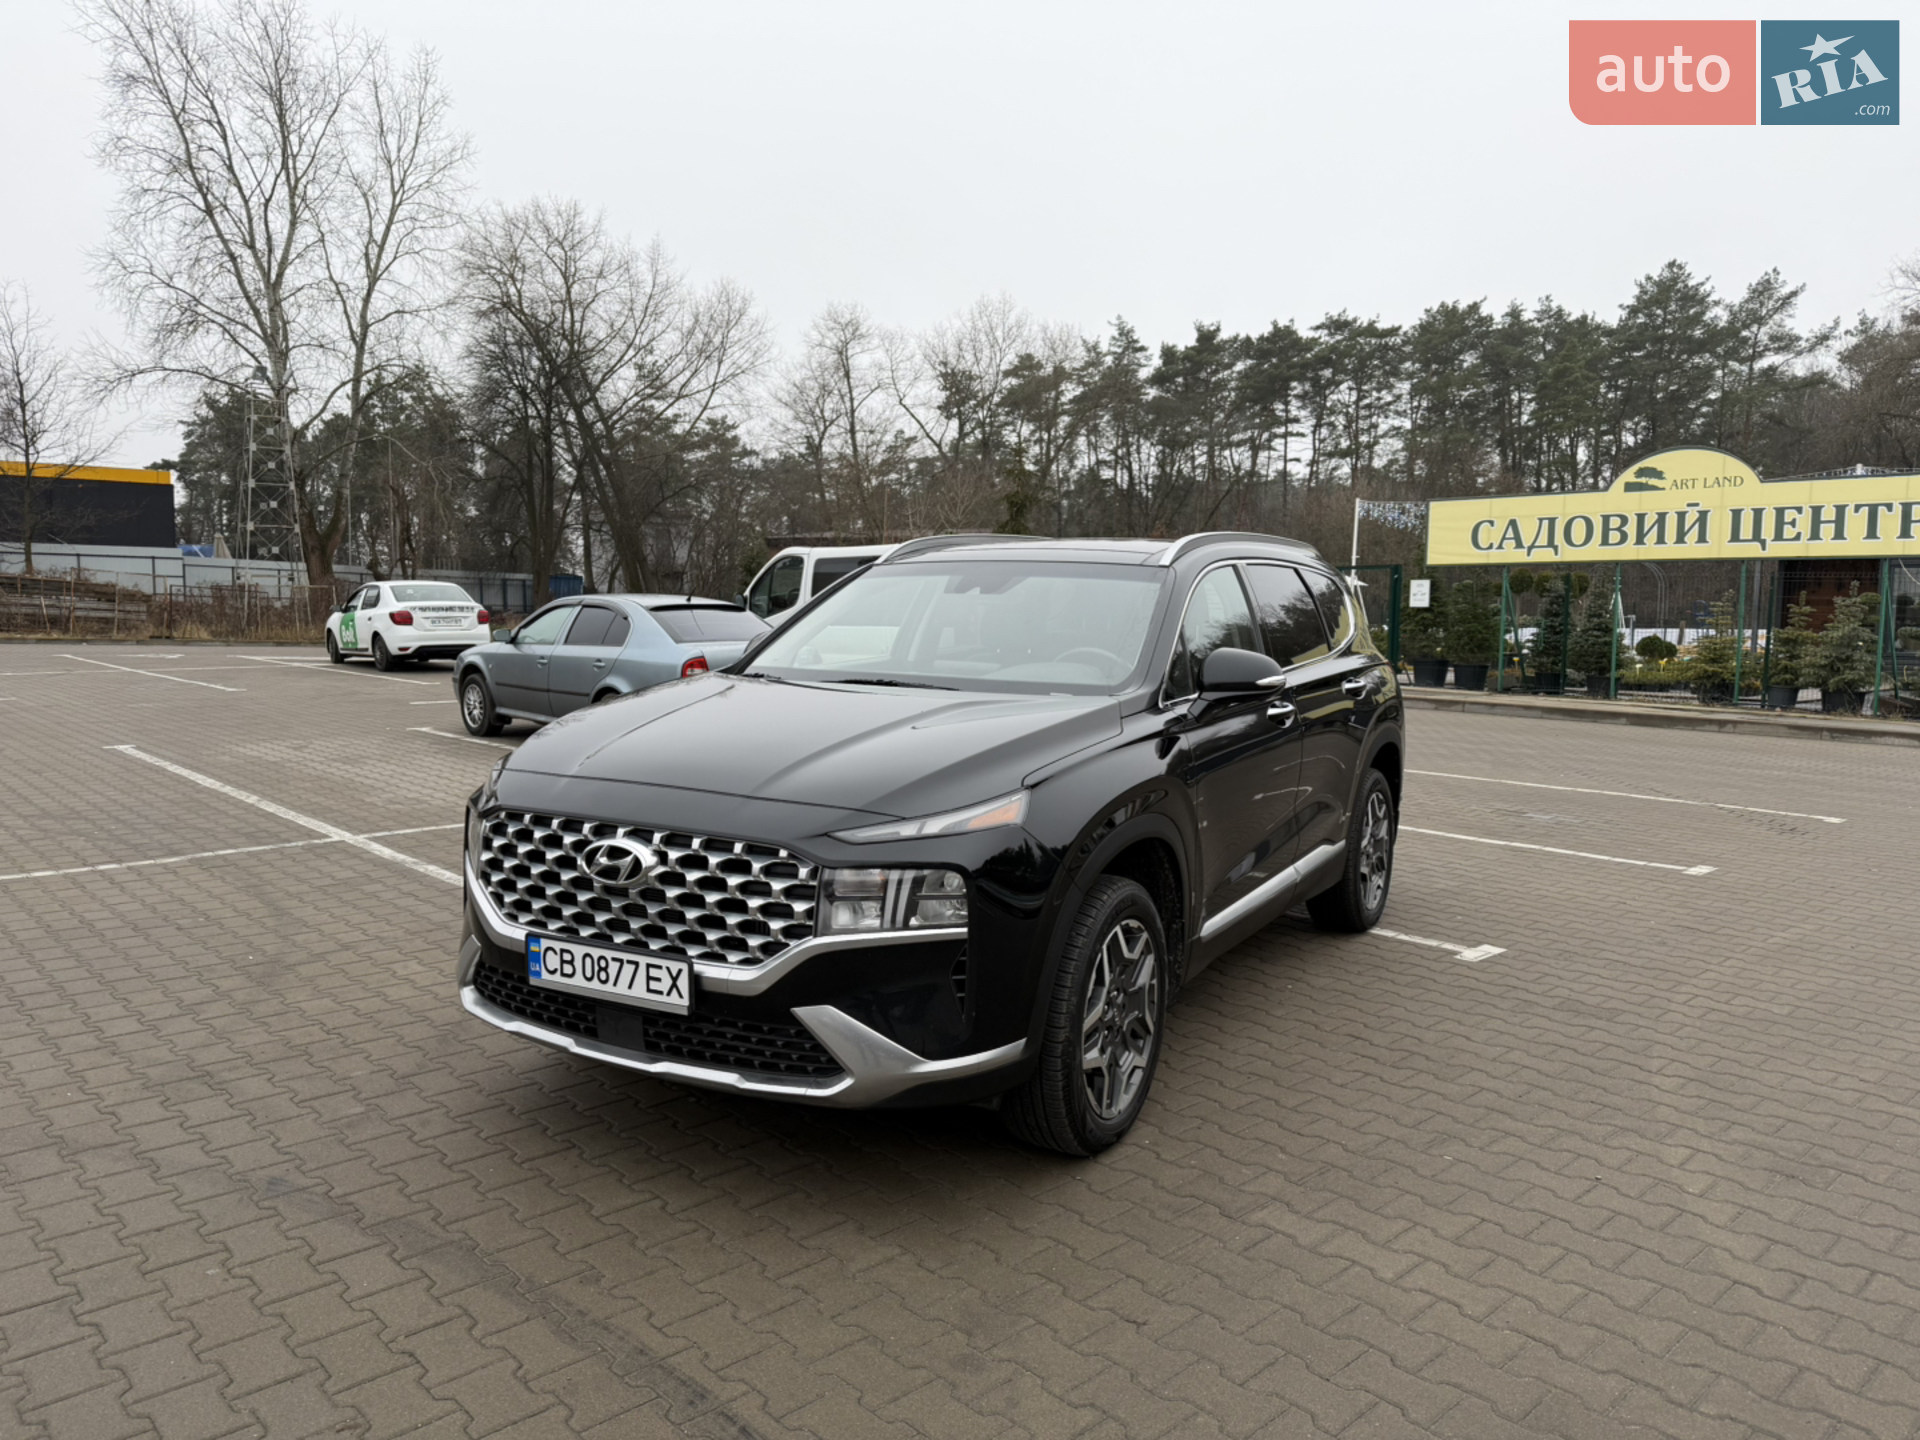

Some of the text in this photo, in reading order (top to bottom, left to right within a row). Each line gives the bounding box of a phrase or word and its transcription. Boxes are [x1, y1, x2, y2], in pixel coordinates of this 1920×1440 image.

[1669, 475, 1745, 490] ART LAND
[1471, 502, 1711, 557] САДОВИЙ
[542, 946, 684, 999] CB 0877 EX
